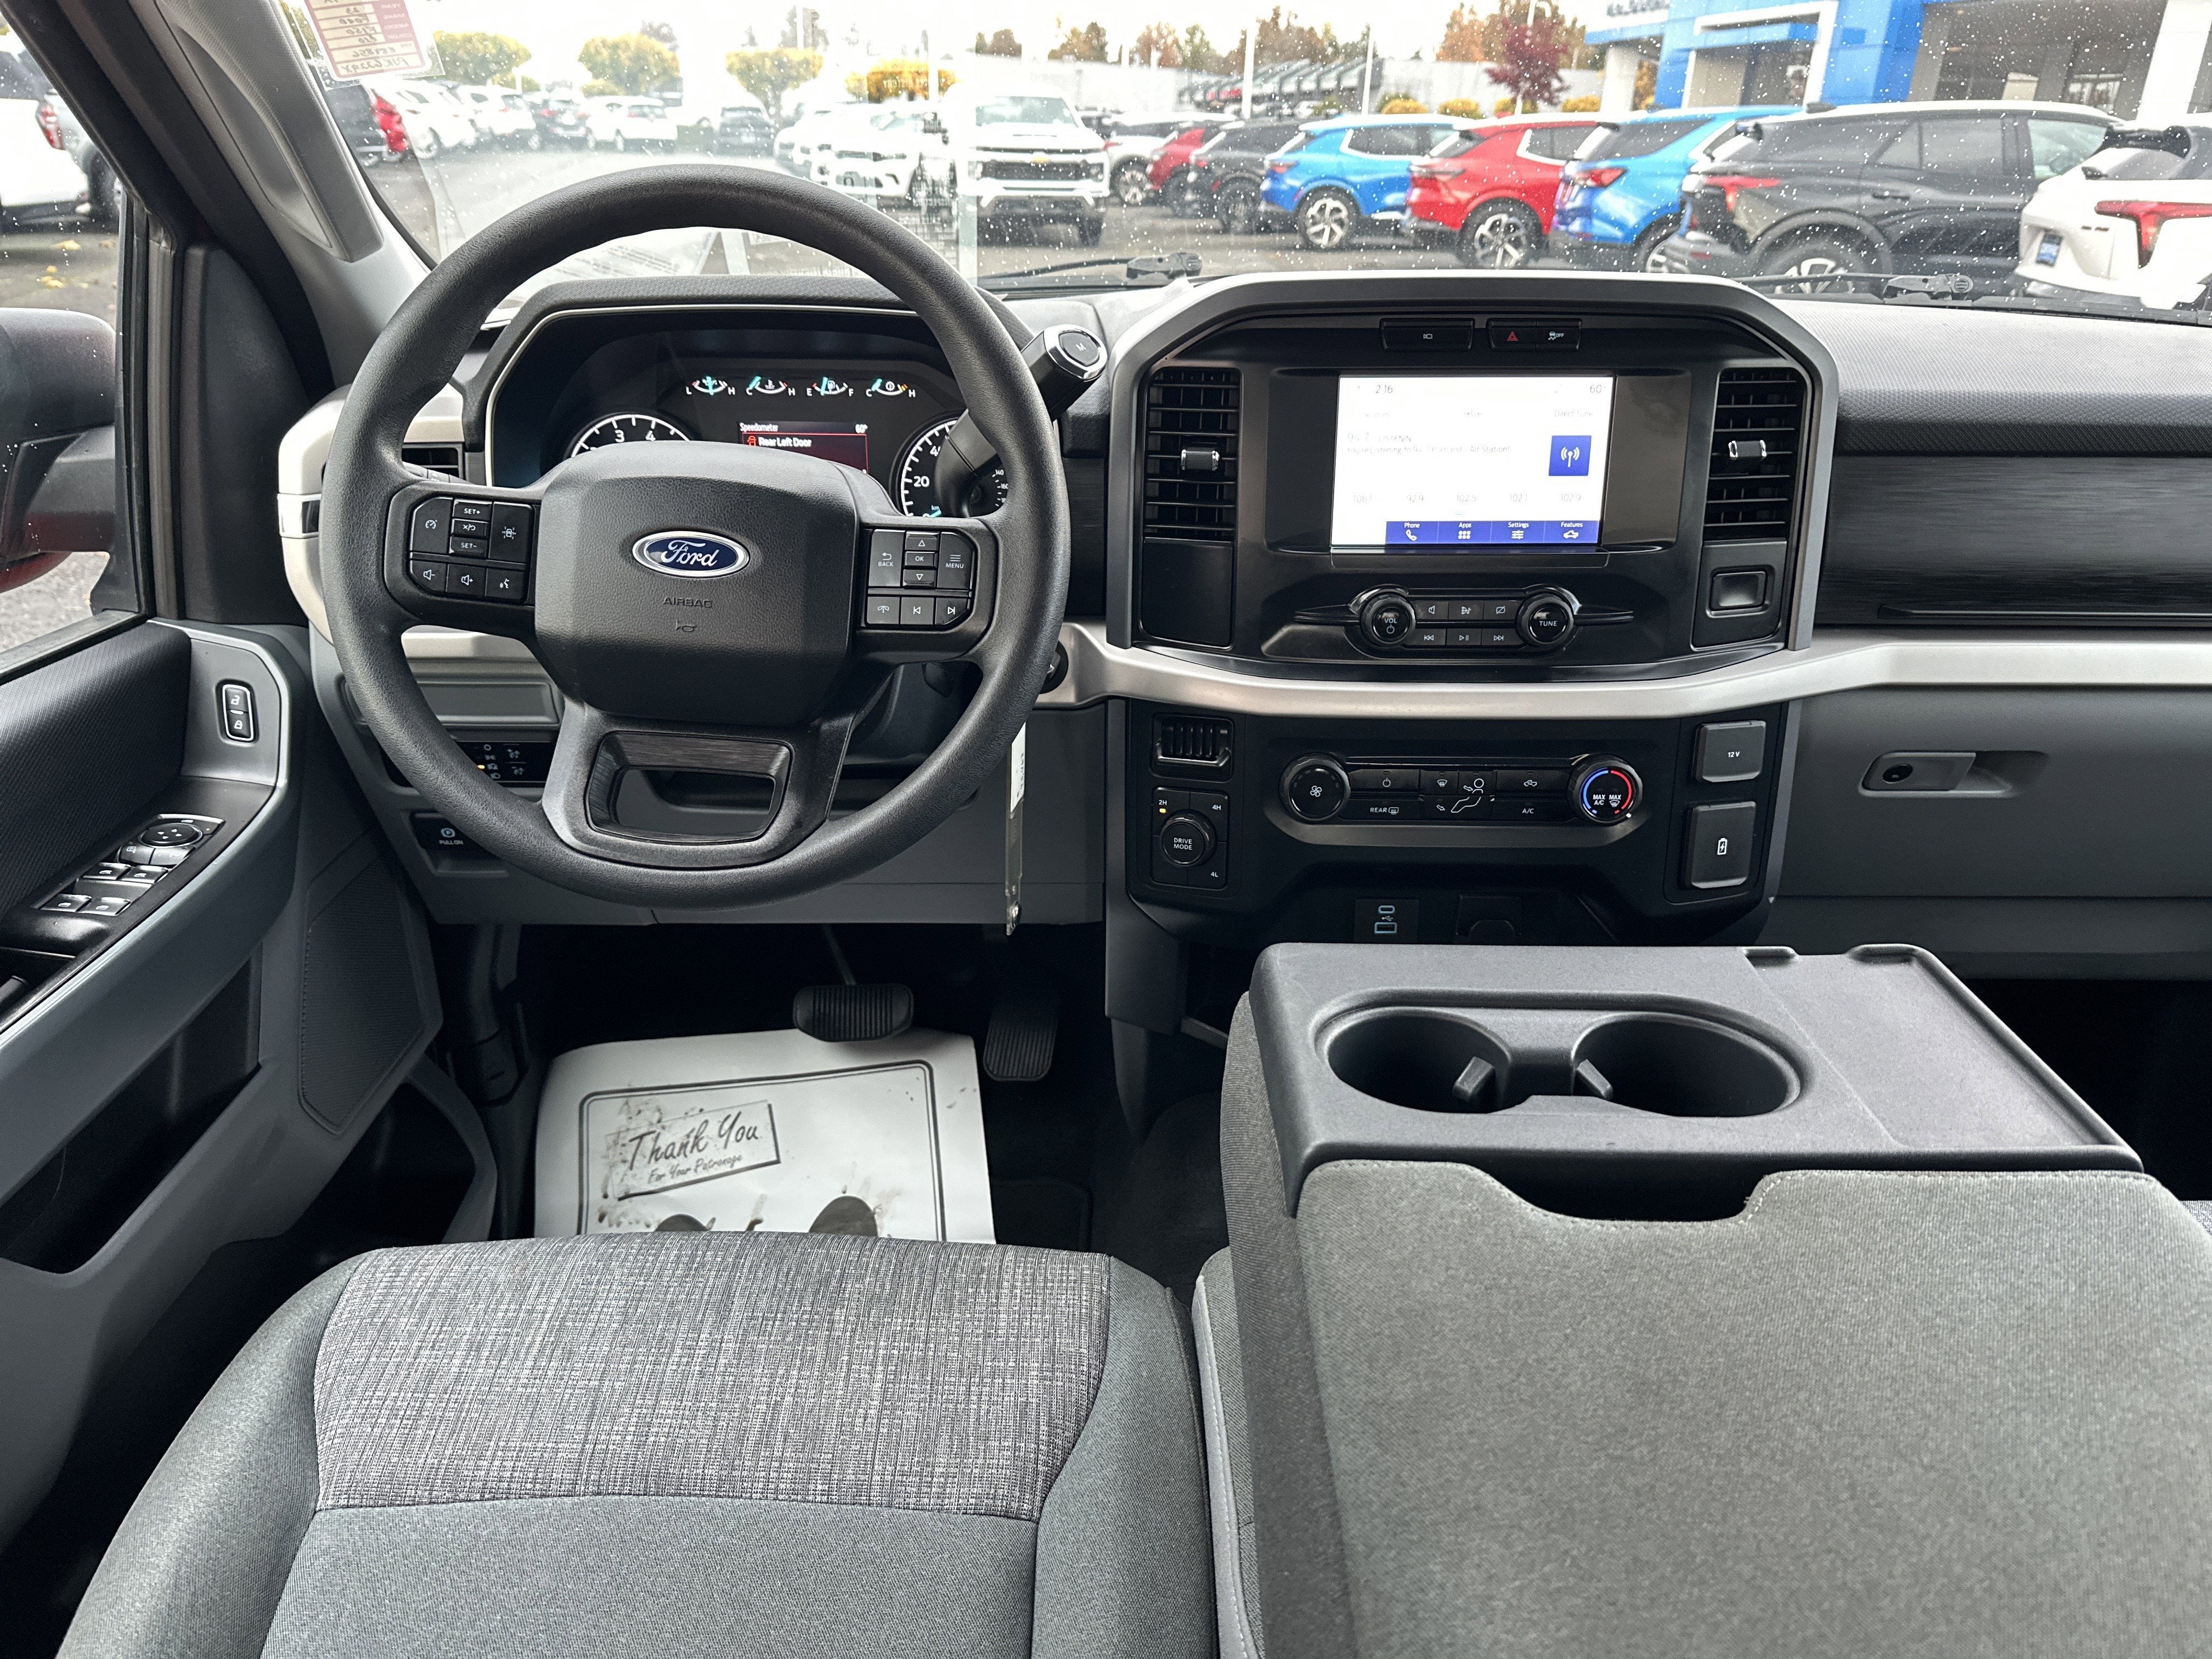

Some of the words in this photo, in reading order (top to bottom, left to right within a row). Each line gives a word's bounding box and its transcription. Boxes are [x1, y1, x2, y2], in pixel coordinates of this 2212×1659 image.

[728, 387, 735, 396] H
[1375, 385, 1393, 394] 216
[740, 422, 778, 432] Speedometer
[615, 430, 625, 442] 3
[645, 430, 656, 442] 4
[758, 437, 776, 447] Rear
[777, 437, 793, 447] Left
[793, 437, 812, 447] Door
[913, 476, 930, 487] 20
[661, 539, 720, 567] Ford
[663, 597, 713, 608] AIRBAG
[628, 1119, 709, 1171] Thank
[718, 1111, 759, 1150] You
[647, 1170, 665, 1184] For
[667, 1164, 689, 1180] Your
[693, 1154, 743, 1174] Patronage
